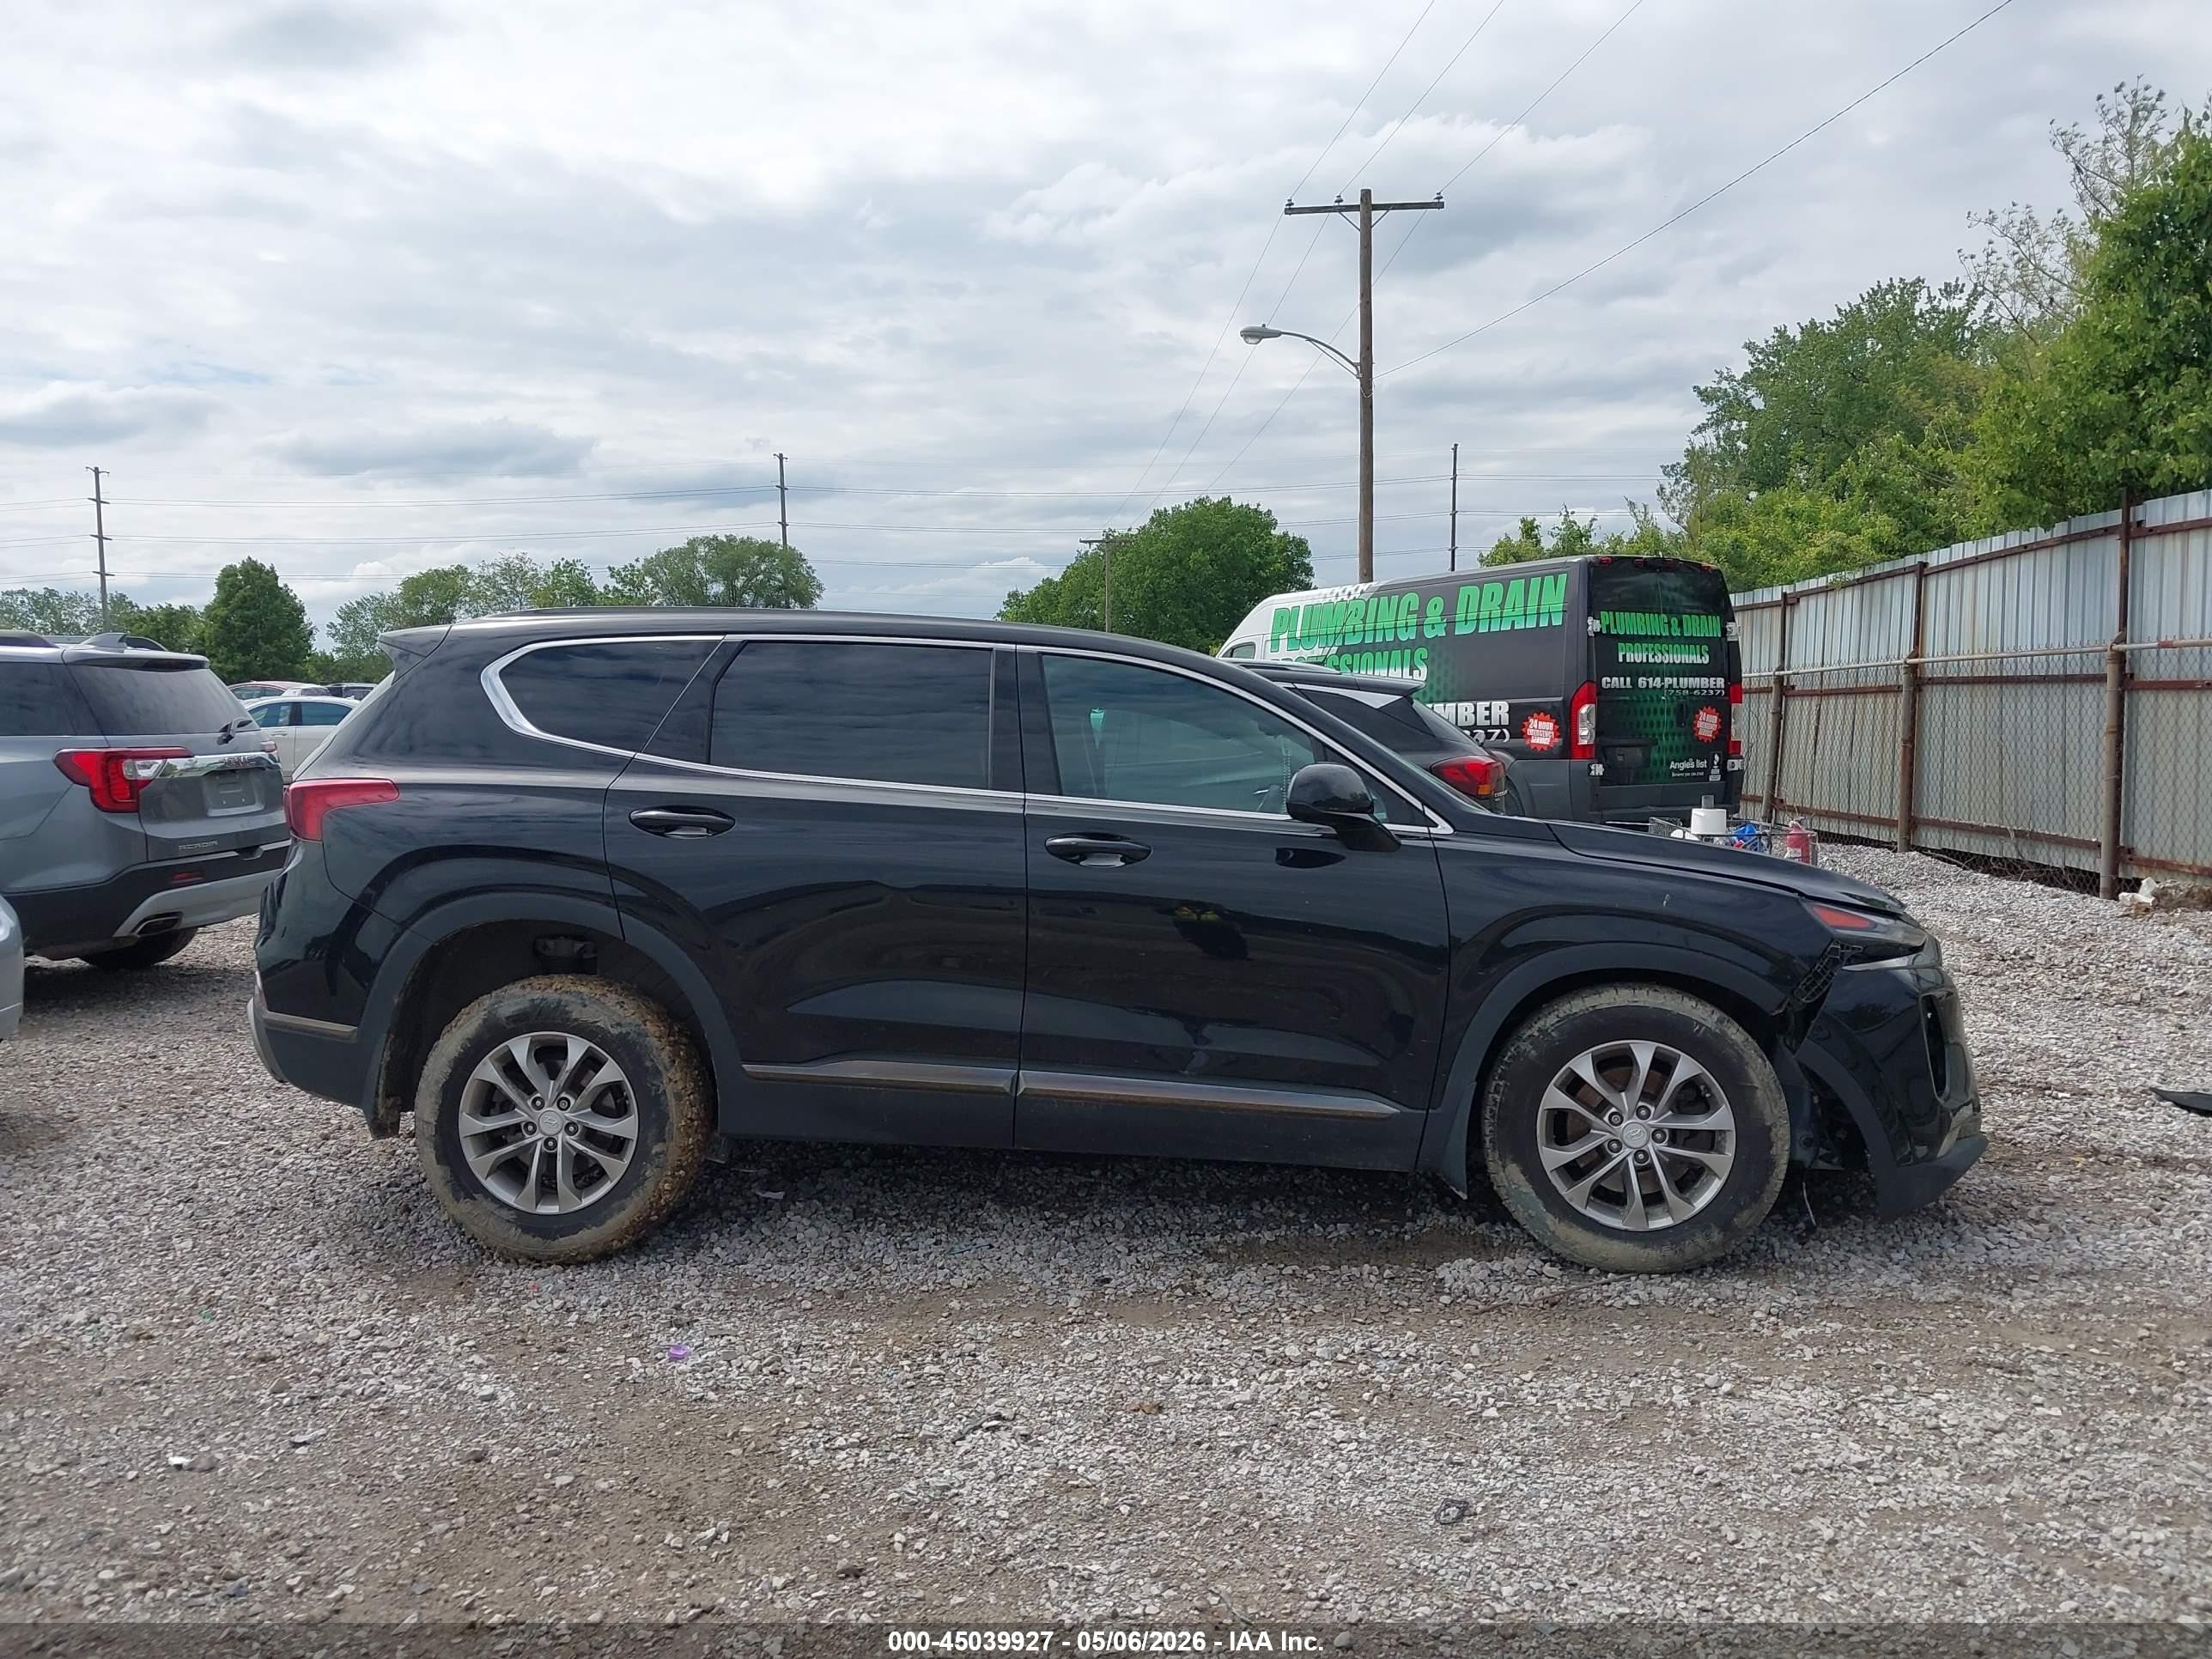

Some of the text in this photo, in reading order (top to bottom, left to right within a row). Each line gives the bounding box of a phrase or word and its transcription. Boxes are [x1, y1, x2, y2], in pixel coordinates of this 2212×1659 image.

[1270, 574, 1568, 653] PLUMBING & DRAIN
[1600, 611, 1722, 638] PLUMBING & DRAIN
[1618, 642, 1710, 665] PROFESSIONALS
[1601, 677, 1725, 689] CALL 614-PLUMBER
[1529, 718, 1553, 731] 24 HOUR
